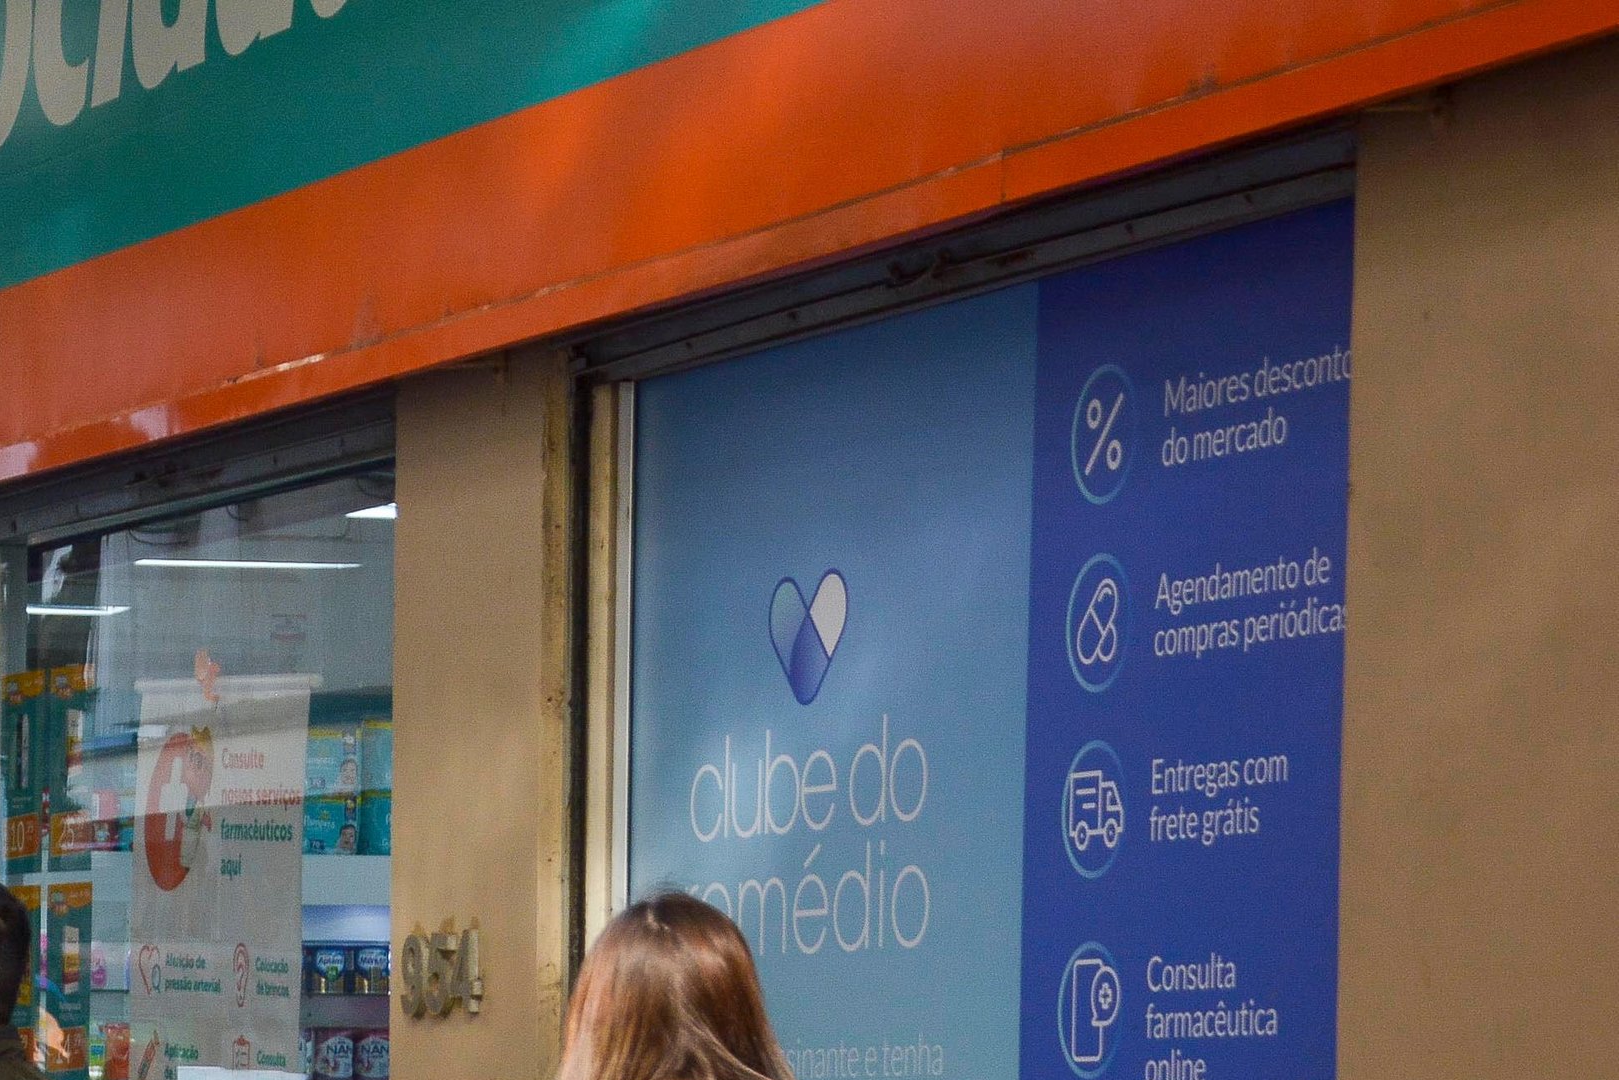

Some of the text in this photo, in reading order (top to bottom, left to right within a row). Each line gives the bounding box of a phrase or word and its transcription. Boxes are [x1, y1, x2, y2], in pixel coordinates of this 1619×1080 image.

[1164, 372, 1249, 418] Maiores
[1162, 406, 1288, 467] do mercado
[1155, 547, 1330, 616] Agendamento de
[1155, 618, 1240, 659] compras
[690, 713, 929, 843] clube do
[1151, 753, 1289, 798] Entregas com
[220, 815, 293, 843] farmacêuticos
[1149, 796, 1260, 846] frete grátis
[400, 928, 483, 1016] 954
[1146, 951, 1237, 993] Consulta
[1145, 998, 1279, 1040] farmacêutica
[882, 1034, 944, 1077] tenha
